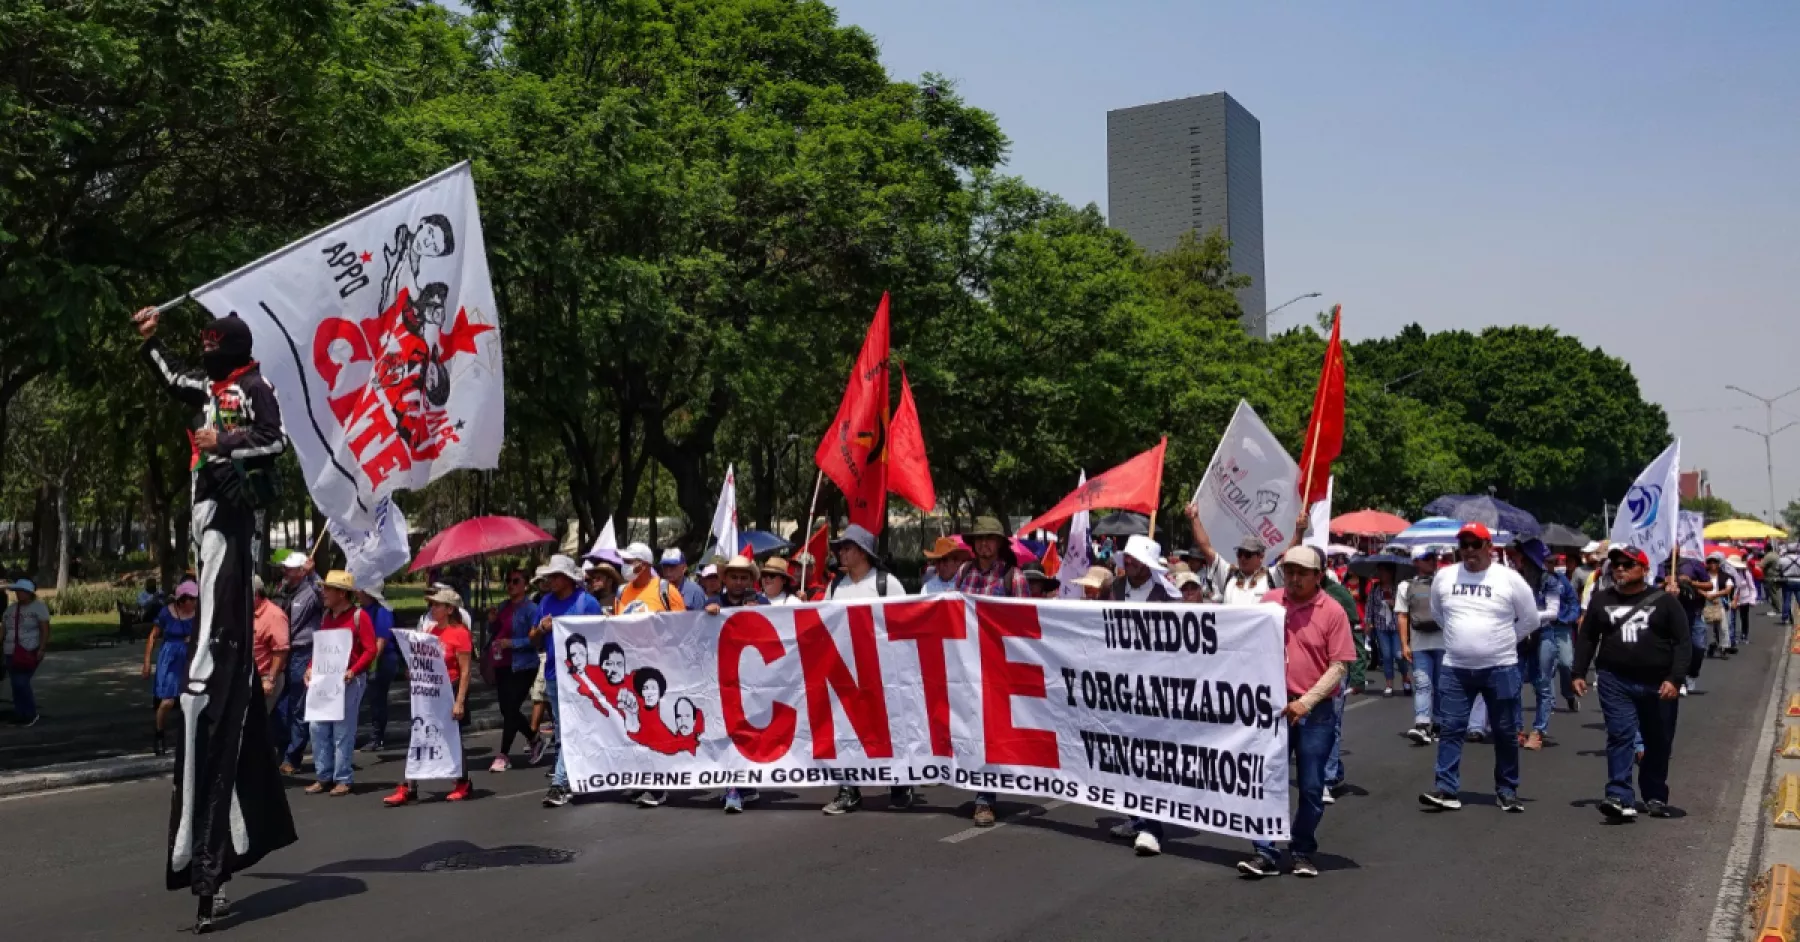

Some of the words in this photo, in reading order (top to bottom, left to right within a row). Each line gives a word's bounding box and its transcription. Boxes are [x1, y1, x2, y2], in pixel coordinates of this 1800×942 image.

[321, 240, 371, 300] APPO
[313, 317, 412, 493] CNTE
[1452, 584, 1492, 598] LEVI'S
[1102, 608, 1218, 655] ¡¡UNIDOS
[717, 599, 1061, 769] CNTE
[1062, 668, 1077, 706] Y
[1080, 671, 1280, 738] ORGANIZADOS,
[698, 768, 763, 786] QUIEN
[770, 766, 900, 786] GOBIERNE,
[908, 764, 951, 781] LOS
[955, 769, 1079, 799] DERECHOS
[1086, 785, 1116, 807] SE
[1123, 791, 1283, 836] DEFIENDEN!!
[1079, 730, 1265, 800] VENCEREMOS!!
